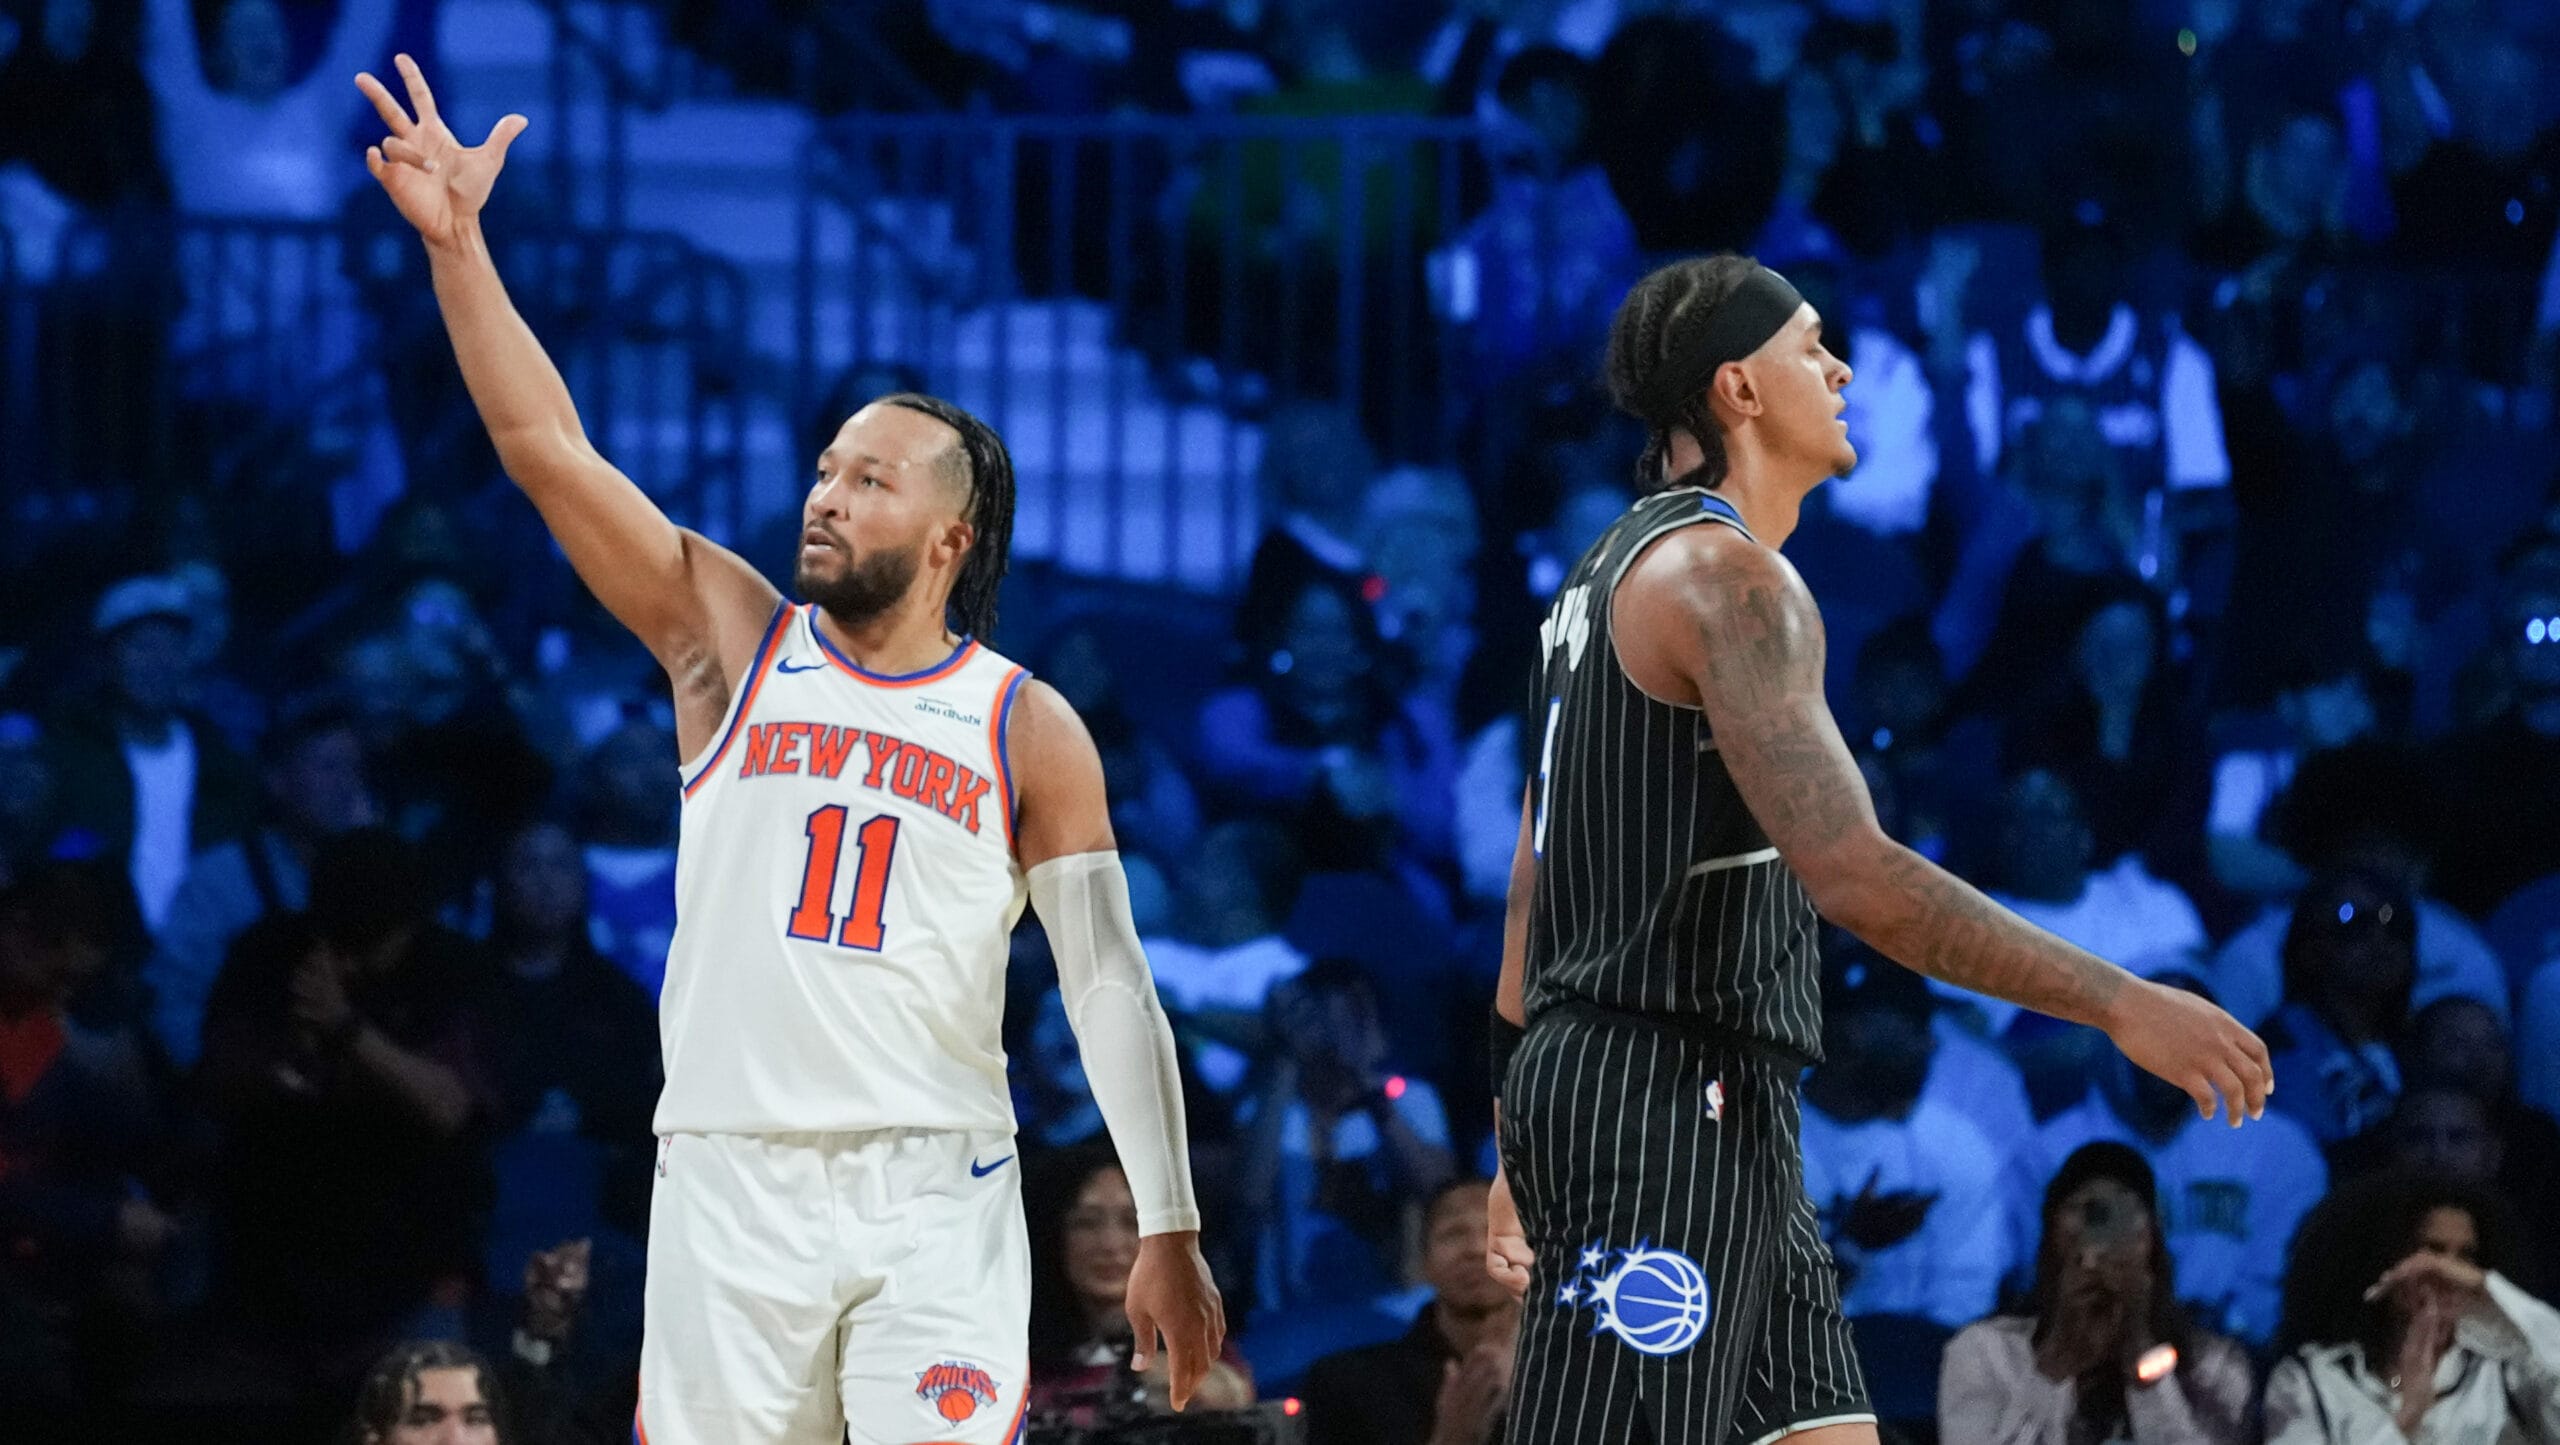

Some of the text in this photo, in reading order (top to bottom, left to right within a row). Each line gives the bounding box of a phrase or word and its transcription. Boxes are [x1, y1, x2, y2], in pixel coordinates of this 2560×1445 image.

[739, 722, 994, 836] NEW YORK
[786, 803, 901, 953] 11
[916, 1364, 997, 1407] KNICKS
